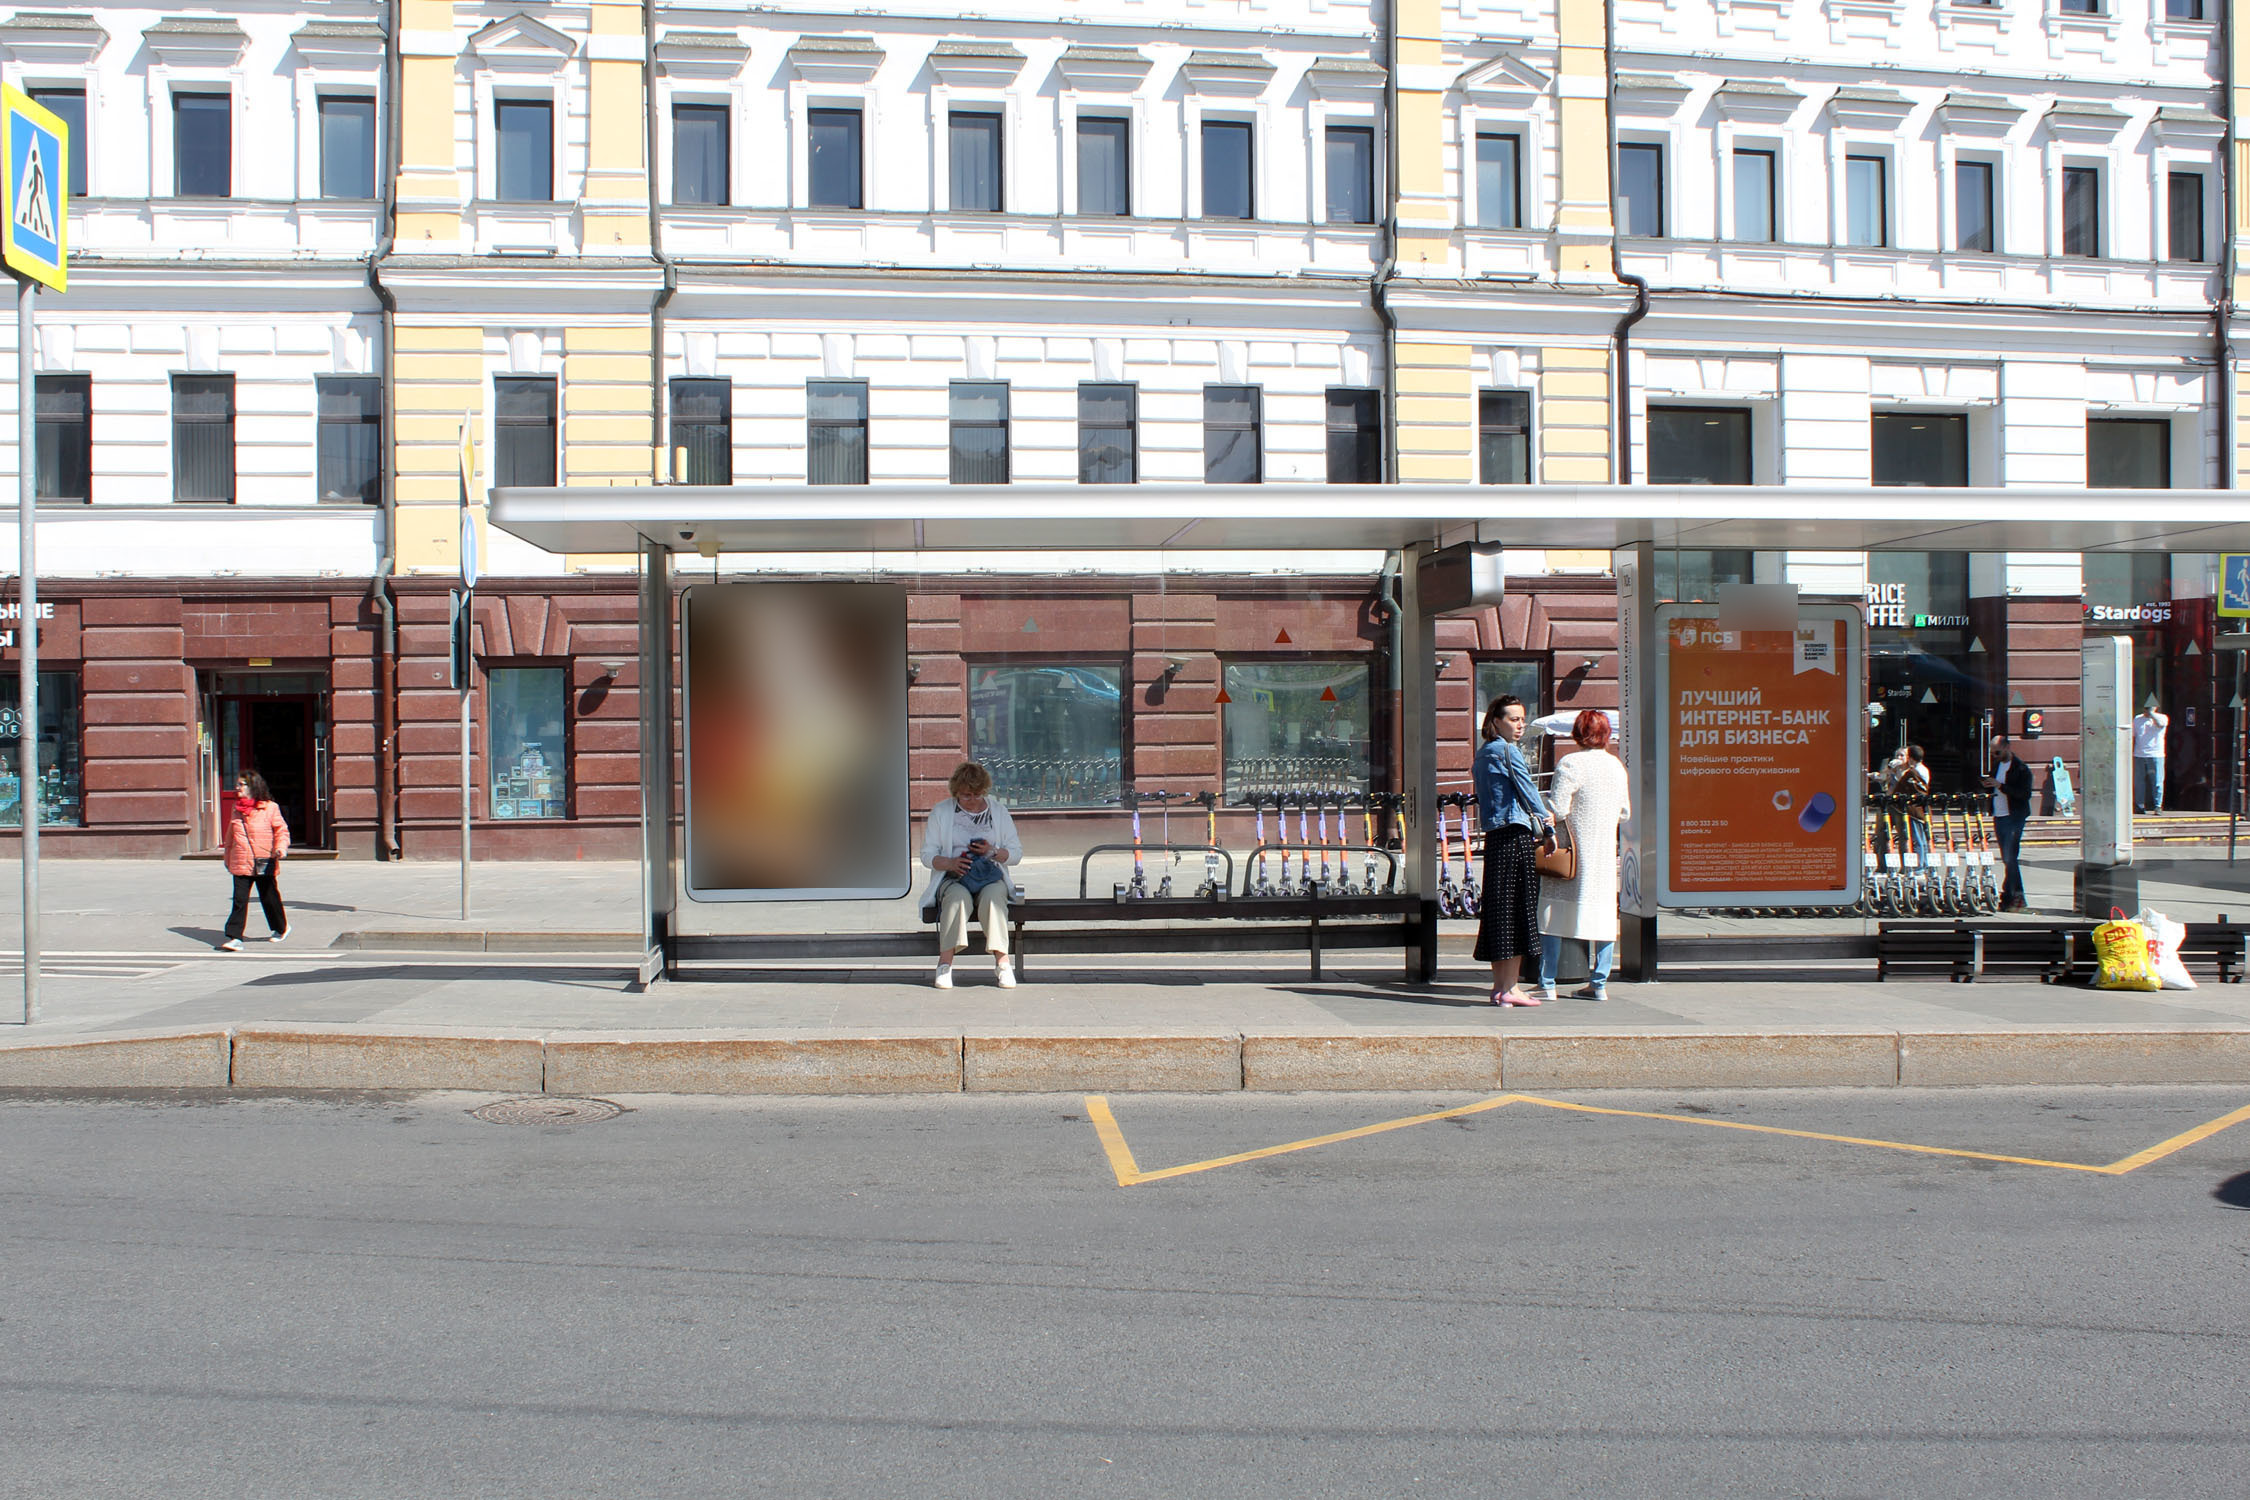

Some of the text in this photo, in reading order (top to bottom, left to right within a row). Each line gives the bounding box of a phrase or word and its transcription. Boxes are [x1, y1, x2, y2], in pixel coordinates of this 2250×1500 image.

[1864, 584, 1905, 604] RICE
[1866, 604, 1905, 627] FFEE
[1927, 615, 1970, 626] МИЛТИ
[2092, 605, 2172, 623] Stardogs
[1701, 631, 1734, 644] ПСБ
[1680, 686, 1761, 706] ЛУЧШИЙ
[1680, 710, 1830, 725] ИНТЕРНЕТ-БАНК
[1680, 730, 1719, 748] ДЛЯ
[1680, 754, 1774, 765] Новейшие практики
[1680, 766, 1800, 776] цифрового обслуживания
